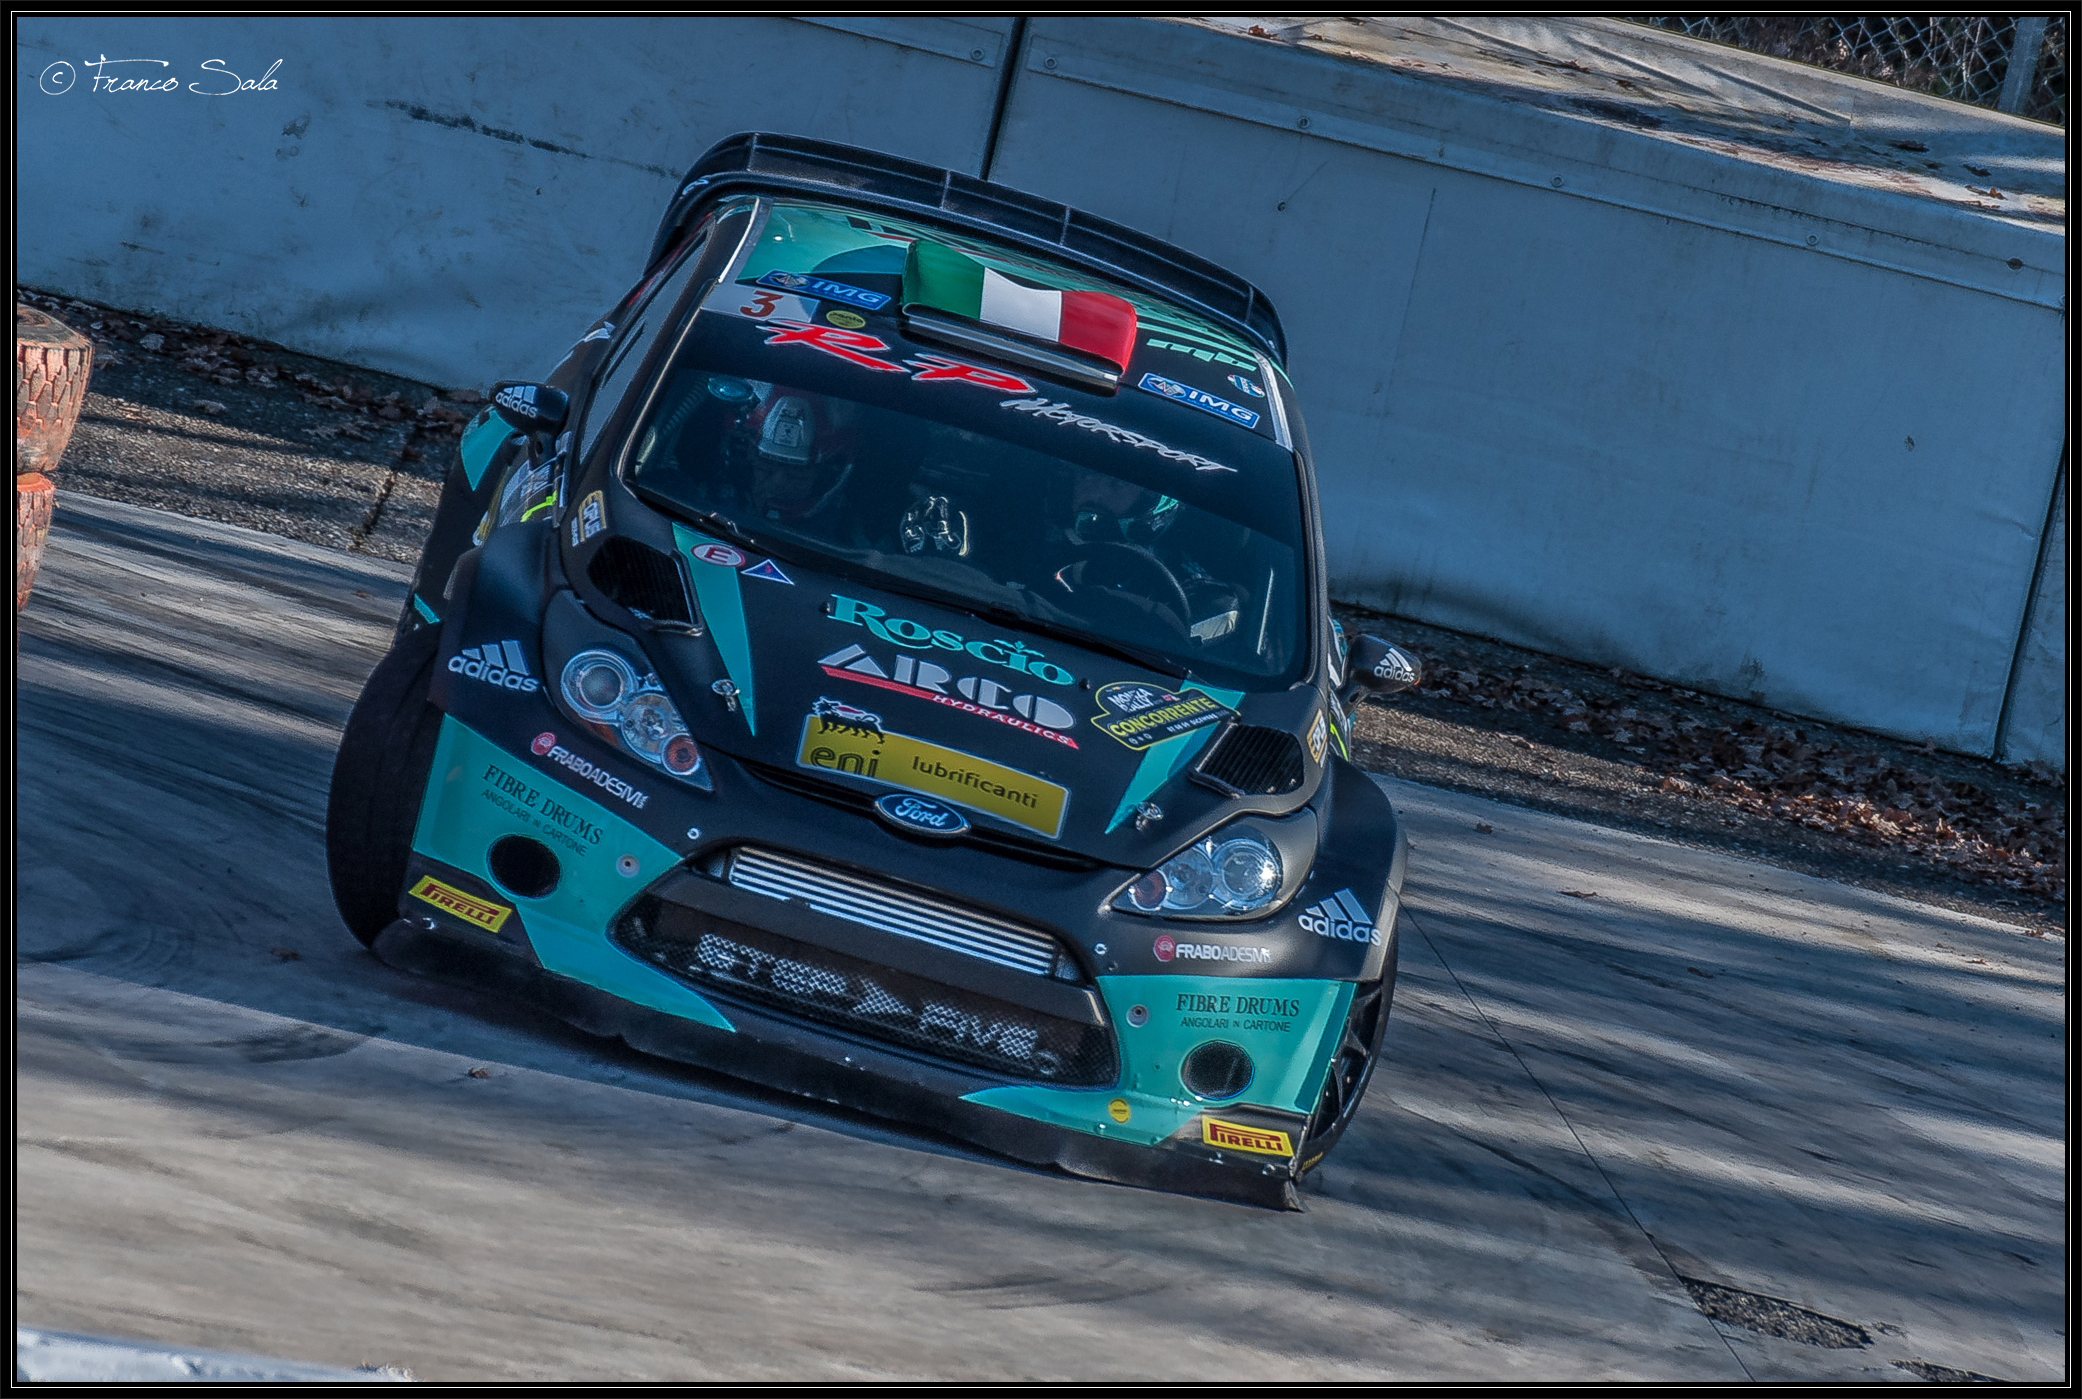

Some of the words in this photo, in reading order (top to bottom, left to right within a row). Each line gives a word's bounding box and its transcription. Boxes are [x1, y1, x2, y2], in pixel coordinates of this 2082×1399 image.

[740, 290, 784, 318] 3
[812, 281, 884, 303] IMG
[495, 390, 538, 420] adidas
[1189, 391, 1254, 421] IMG
[704, 547, 732, 563] E
[448, 655, 540, 692] adidas
[1374, 665, 1415, 682] adidas
[932, 694, 1073, 746] HYDRAULICS
[1110, 698, 1216, 736] CONCORRENTE
[810, 745, 882, 778] eni
[912, 756, 1039, 810] lubrificanti
[481, 763, 536, 809] FIBRE
[540, 791, 604, 846] DRUMS
[894, 798, 947, 830] Ford
[482, 788, 532, 823] ANGOLARI
[543, 818, 588, 858] CARTONE
[421, 883, 500, 926] PIRELLI
[1298, 913, 1382, 947] adidas
[1175, 993, 1230, 1014] FIBRE
[1236, 996, 1300, 1017] DRUMS
[1180, 1016, 1229, 1029] ANGOLARI
[1243, 1019, 1291, 1033] CARTONE
[1209, 1123, 1284, 1153] PIRELLI
